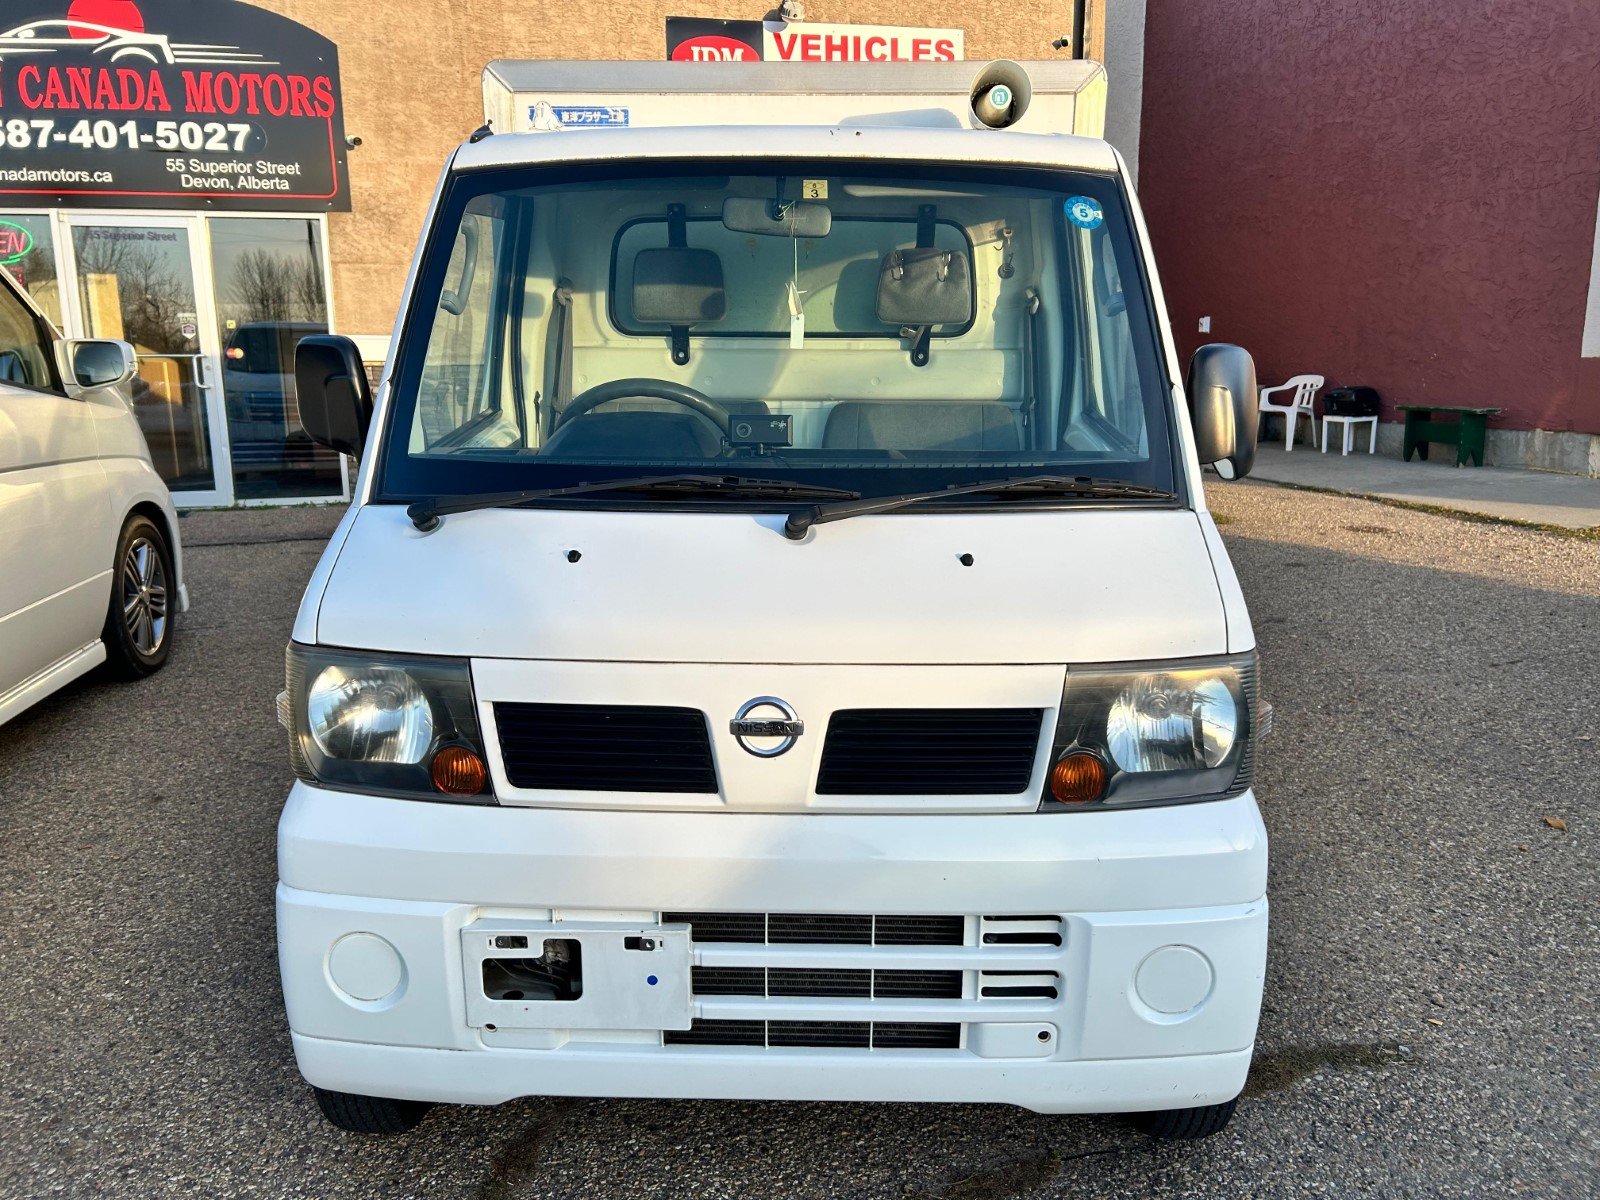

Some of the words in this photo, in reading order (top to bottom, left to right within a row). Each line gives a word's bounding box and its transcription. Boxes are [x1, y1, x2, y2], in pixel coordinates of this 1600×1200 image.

[685, 45, 744, 62] JDM
[772, 32, 955, 62] VEHICLES
[17, 65, 172, 112] CANADA
[181, 70, 335, 119] MOTORS
[165, 158, 186, 172] 55
[189, 159, 252, 176] Superior
[255, 160, 302, 175] Street
[180, 174, 234, 191] Devon,
[237, 175, 290, 191] Alberta
[810, 189, 819, 198] 3
[1079, 208, 1089, 218] 5
[101, 230, 145, 242] Superior
[147, 230, 177, 242] Street
[737, 721, 795, 733] NISSAN
